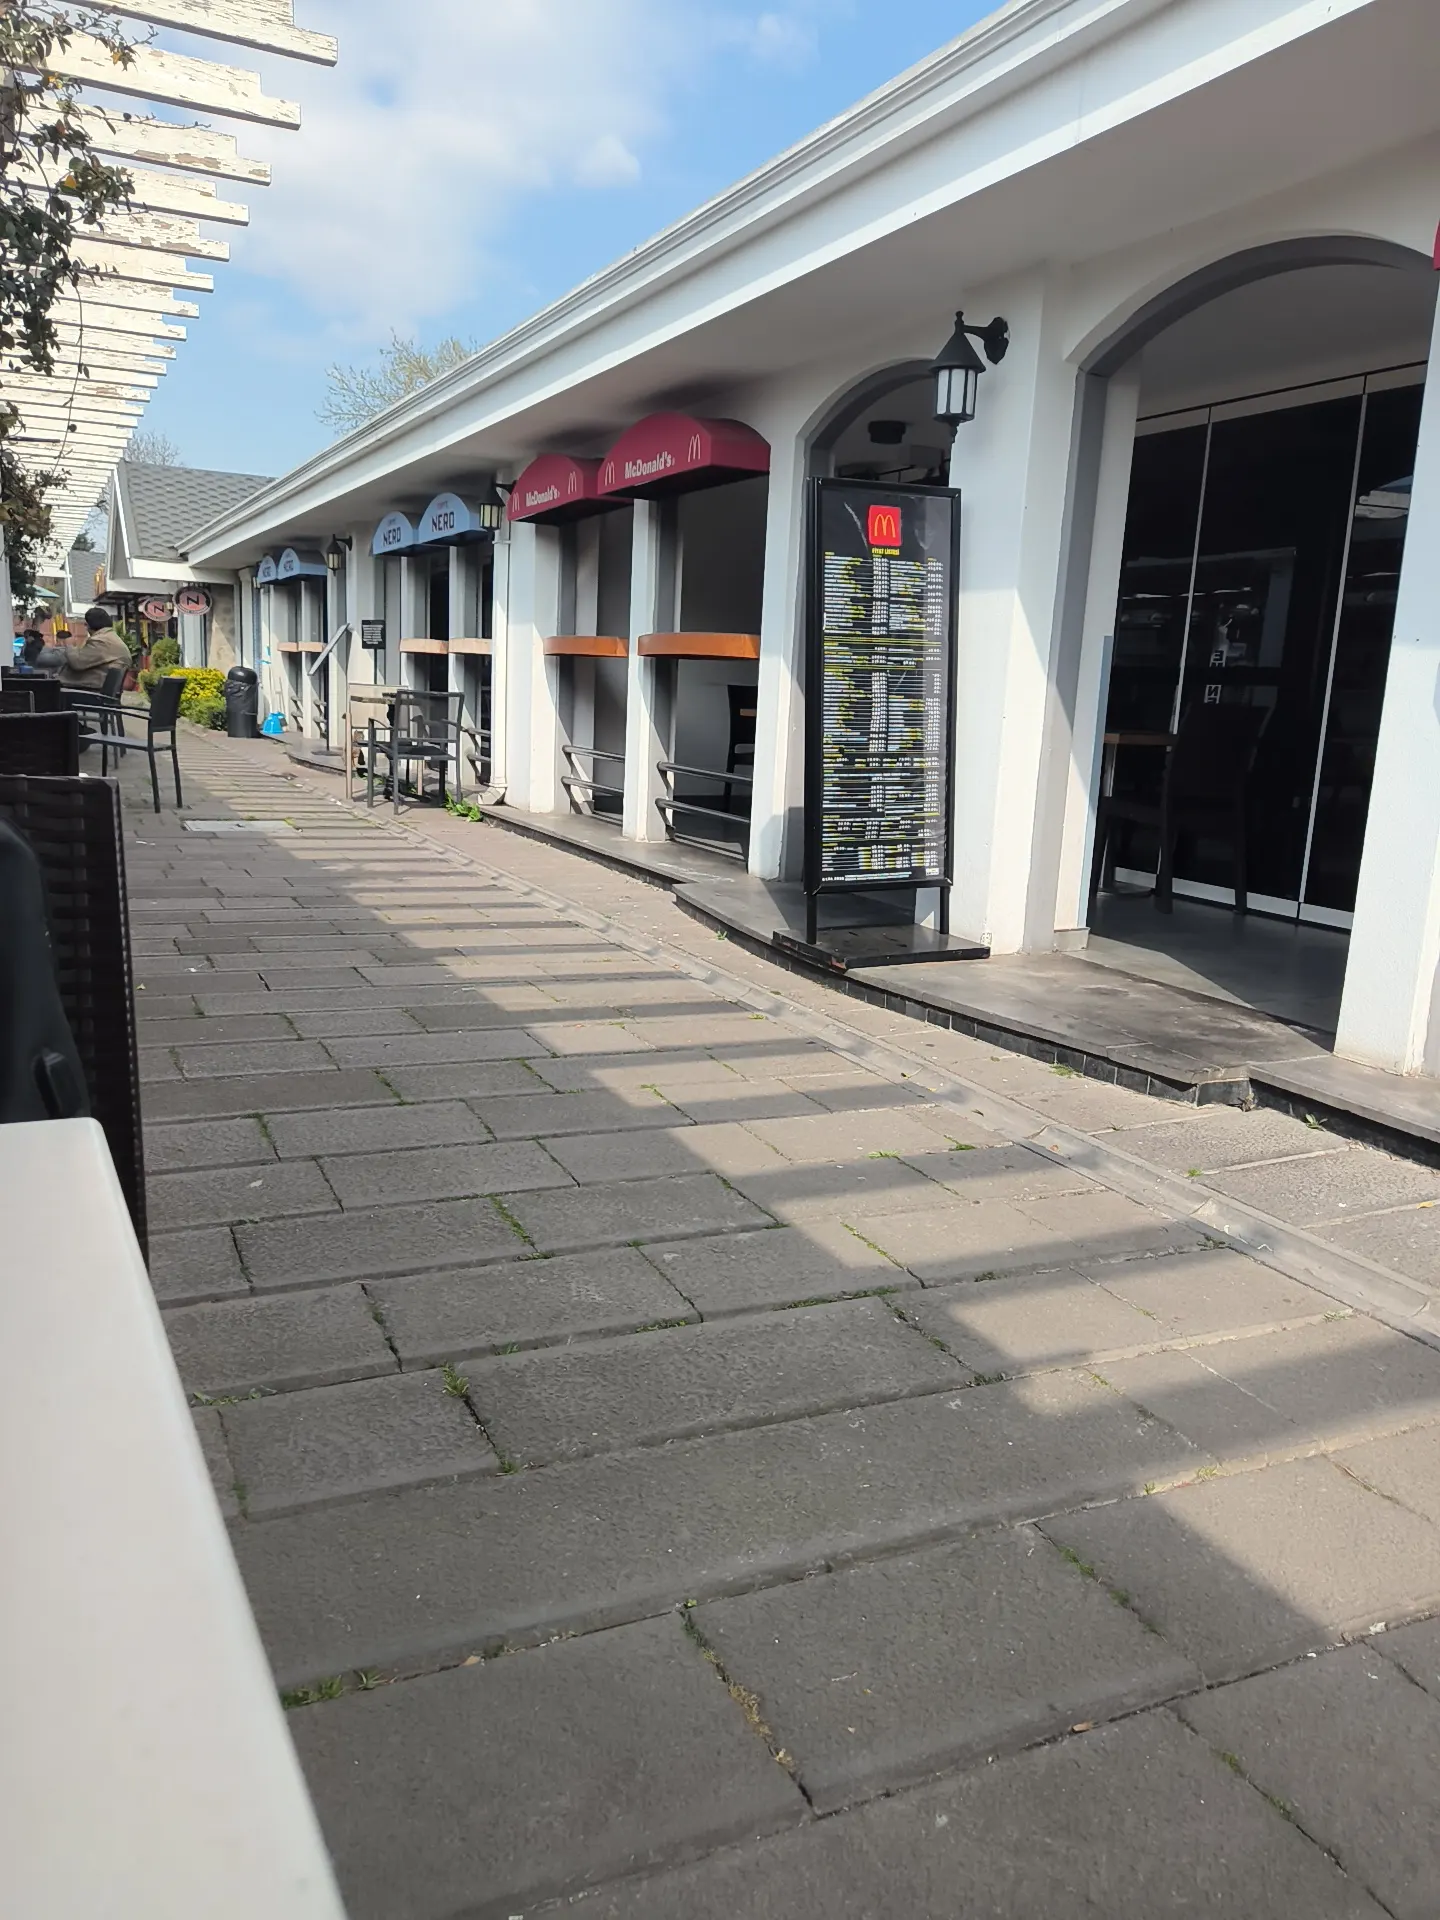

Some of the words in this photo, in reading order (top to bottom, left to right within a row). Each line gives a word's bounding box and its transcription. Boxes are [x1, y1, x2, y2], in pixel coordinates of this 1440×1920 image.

[624, 451, 673, 479] McDonald's
[525, 485, 558, 507] McDonald's
[432, 511, 455, 533] NERO
[383, 527, 402, 547] NERO
